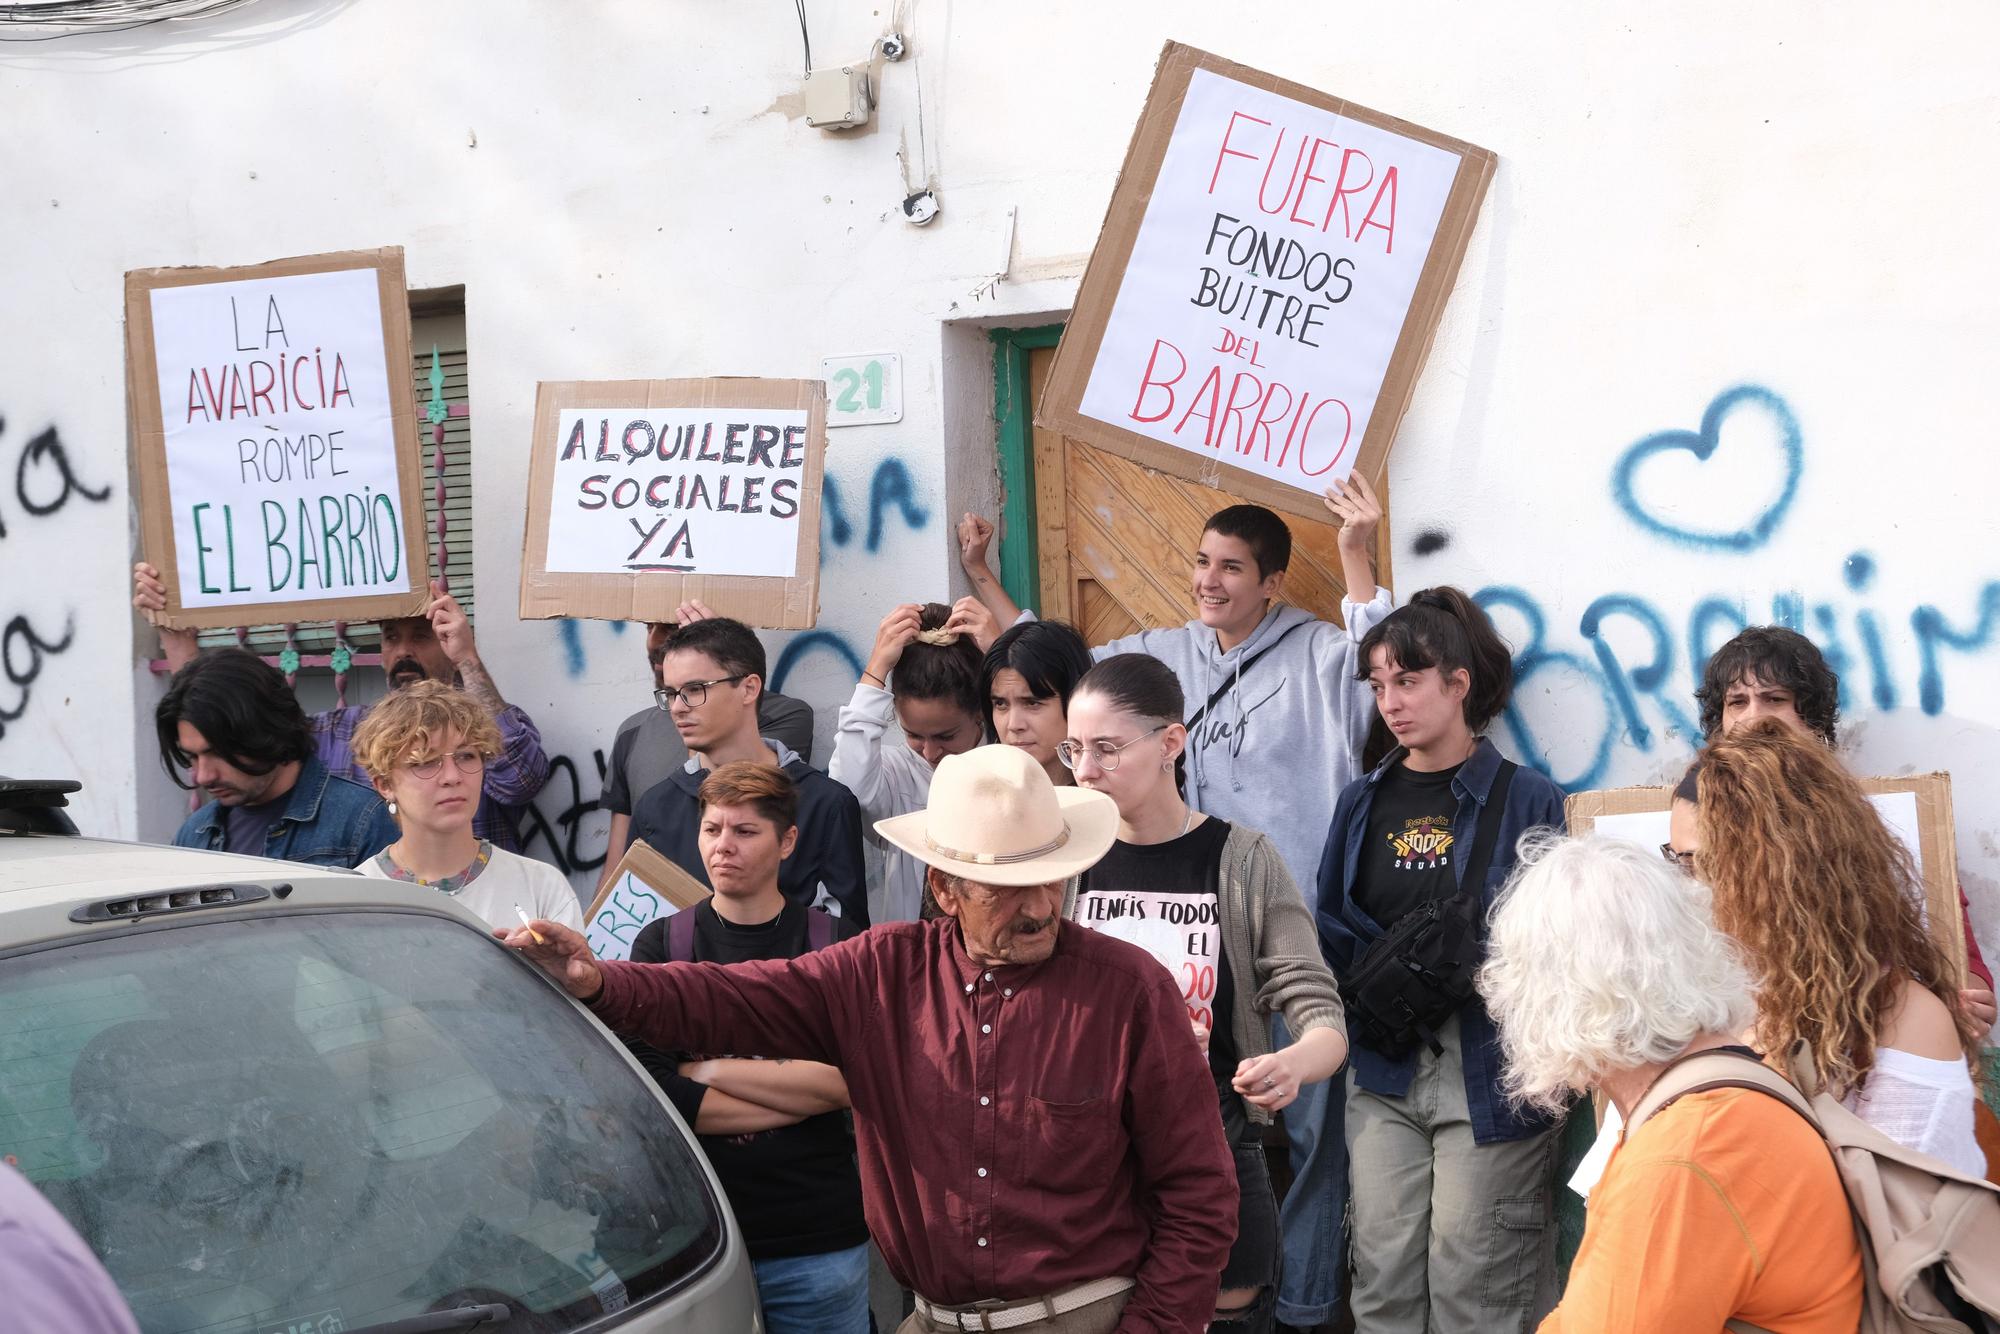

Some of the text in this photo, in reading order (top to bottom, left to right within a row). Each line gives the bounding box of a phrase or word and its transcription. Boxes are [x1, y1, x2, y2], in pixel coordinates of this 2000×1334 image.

[1208, 111, 1398, 254] FUERA
[1204, 212, 1356, 304] FONDOS
[230, 294, 289, 352] LA
[1190, 266, 1331, 348] BUITRE
[1212, 326, 1266, 369] DEL
[832, 359, 884, 414] 21
[1127, 338, 1351, 477] BARRIO
[560, 417, 807, 470] ALQUILERE
[577, 473, 799, 520] SOCIALES
[192, 501, 251, 594] EL
[626, 517, 695, 562] YA
[1403, 833, 1447, 854] HOOP
[1405, 815, 1449, 829] Reebok
[1394, 856, 1448, 870] SQUAD
[1157, 901, 1219, 926] TODOS
[1187, 932, 1211, 957] EL
